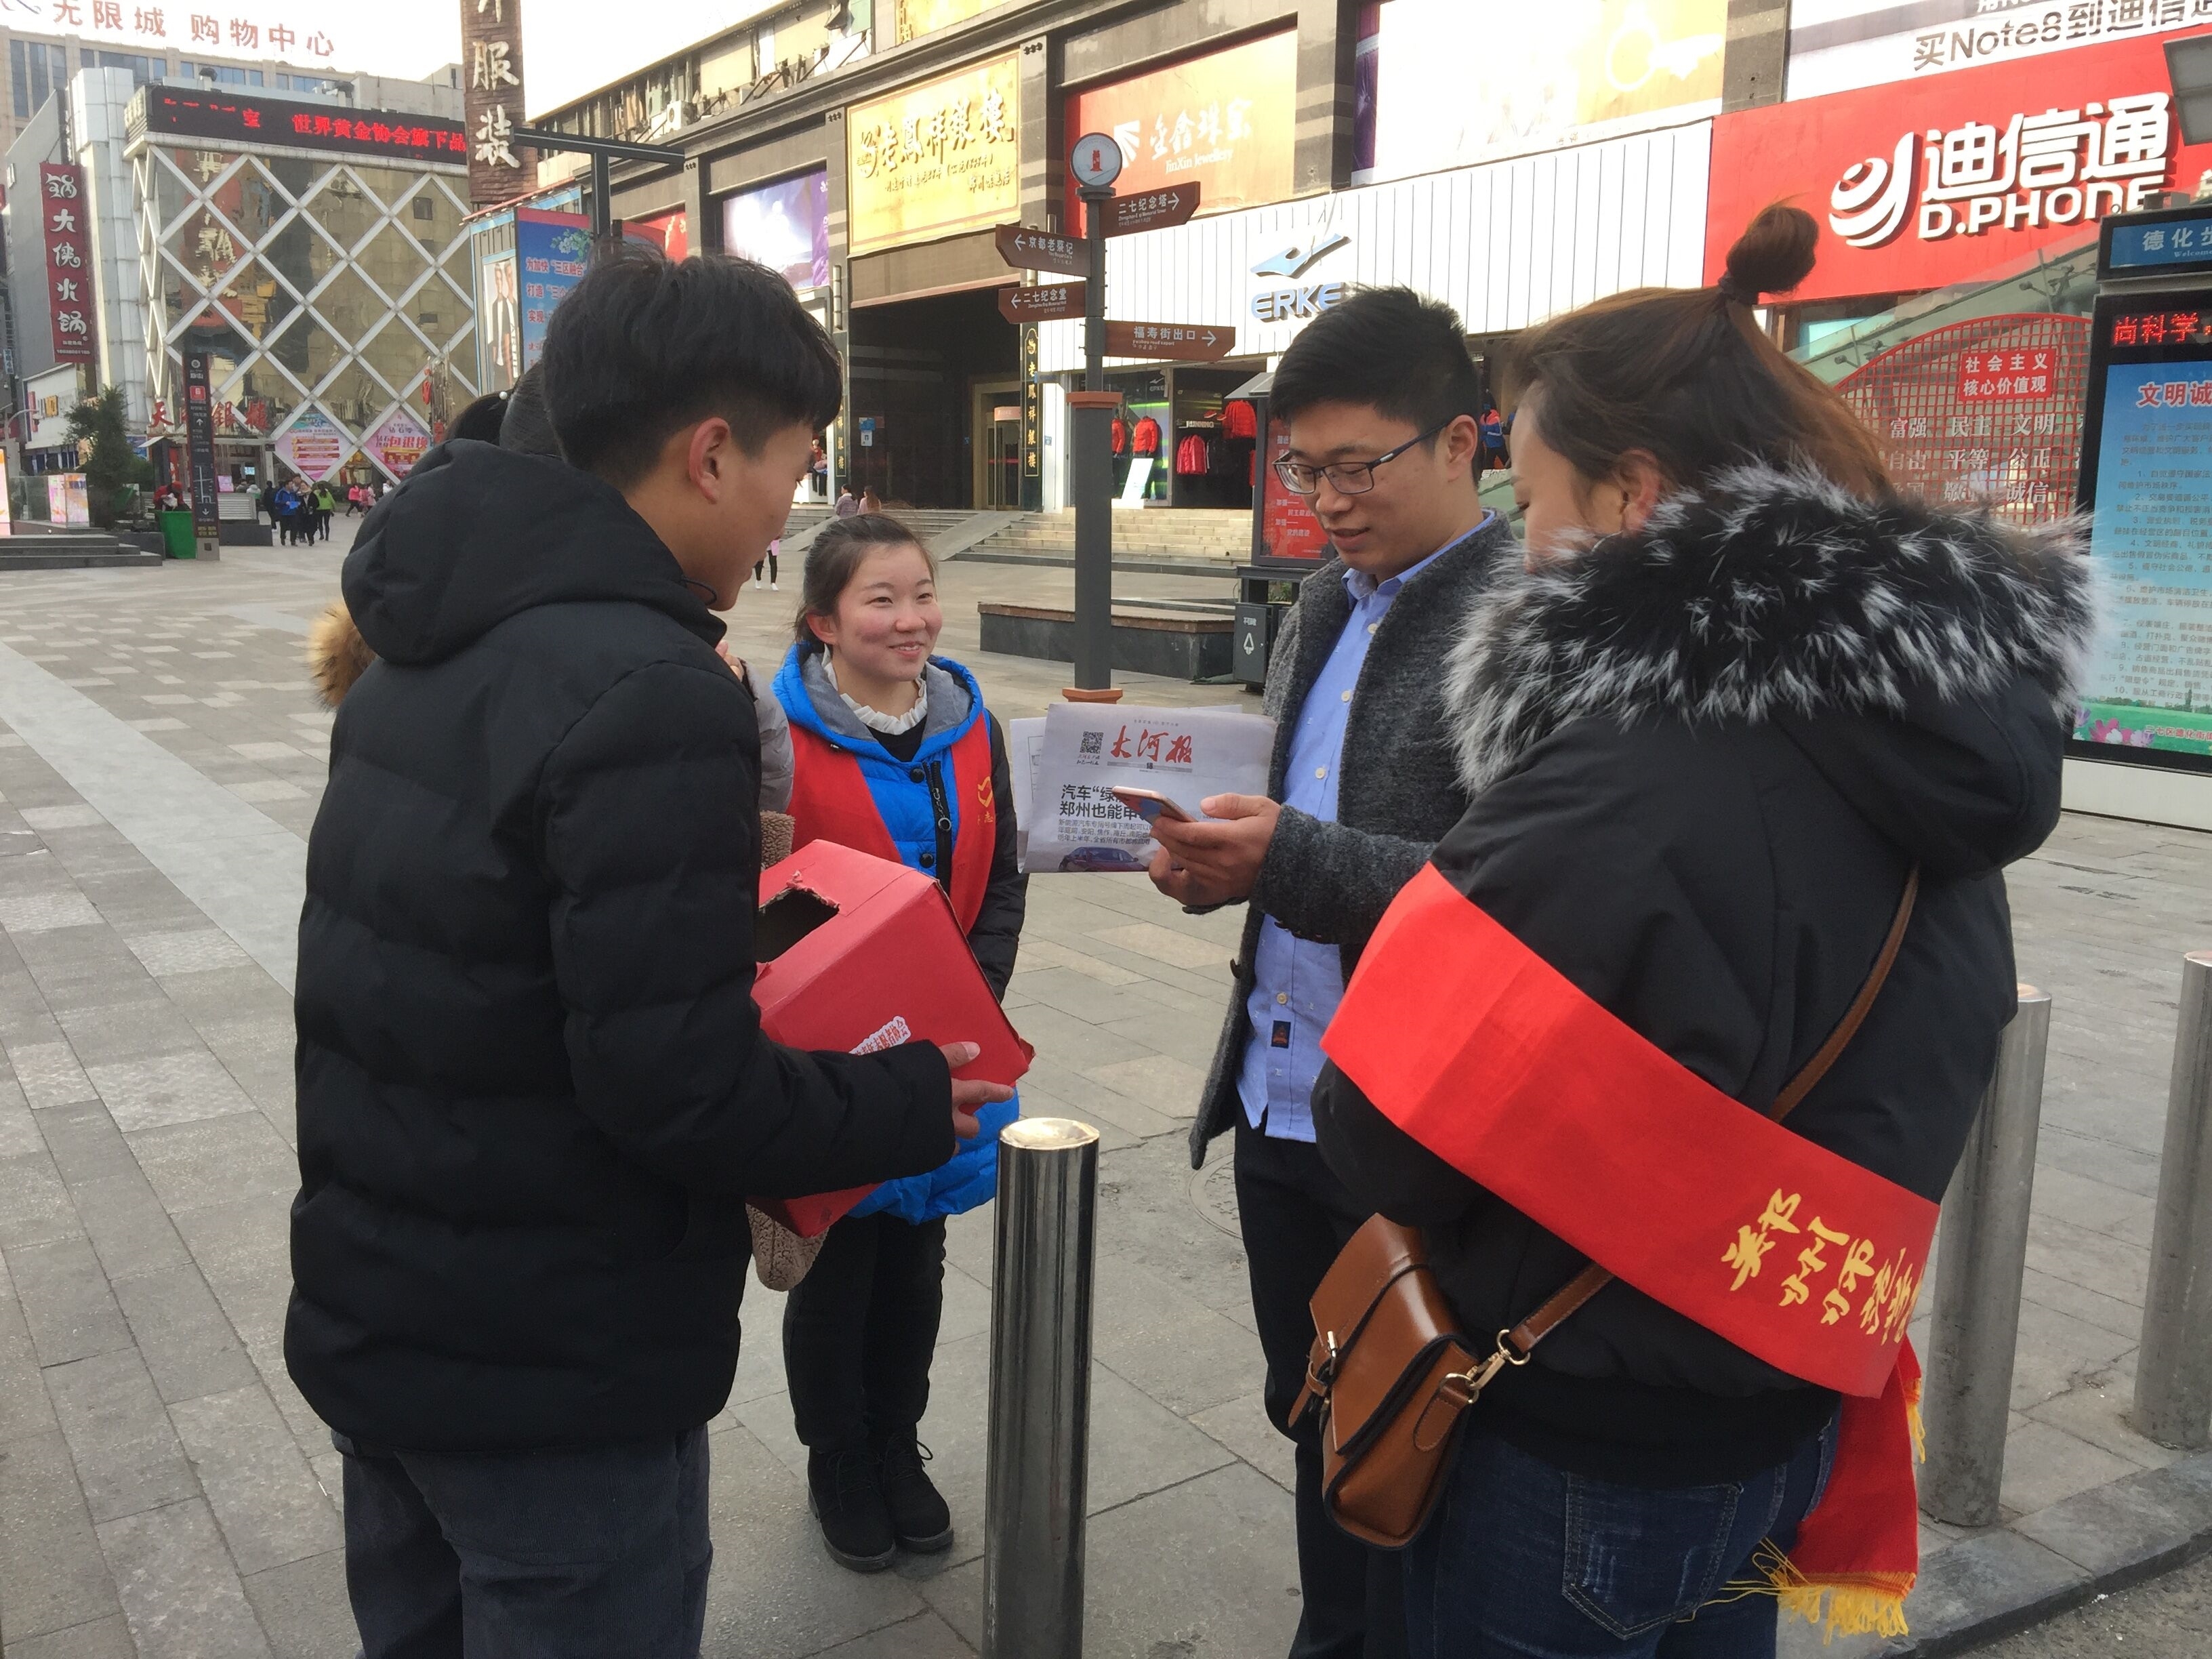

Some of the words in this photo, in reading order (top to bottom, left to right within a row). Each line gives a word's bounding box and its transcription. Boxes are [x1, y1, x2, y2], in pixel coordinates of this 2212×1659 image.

[53, 0, 167, 37] 无限城
[190, 13, 335, 58] 购物中心
[1922, 91, 2169, 203] 迪信通
[1119, 193, 1167, 214] 二七纪念塔
[1029, 236, 1073, 255] 京都老蔡记
[1023, 287, 1067, 303] 二七纪念堂
[1250, 281, 1344, 321] ERKE
[1134, 326, 1195, 341] 福寿街出口
[1965, 353, 2049, 373] 社会主义
[1963, 375, 2047, 397] 核心价值观
[1890, 417, 1928, 439] 富强
[1951, 415, 1992, 438] 民主
[2011, 413, 2055, 436] 文明
[1889, 449, 1927, 471] 自由
[1942, 448, 1989, 470] 平等
[2007, 447, 2052, 469] 公正
[2005, 481, 2049, 504] 诚信
[1110, 724, 1193, 764] 大河报
[1061, 783, 1122, 803] 汽车“绿
[1059, 800, 1146, 821] 郑州也能申
